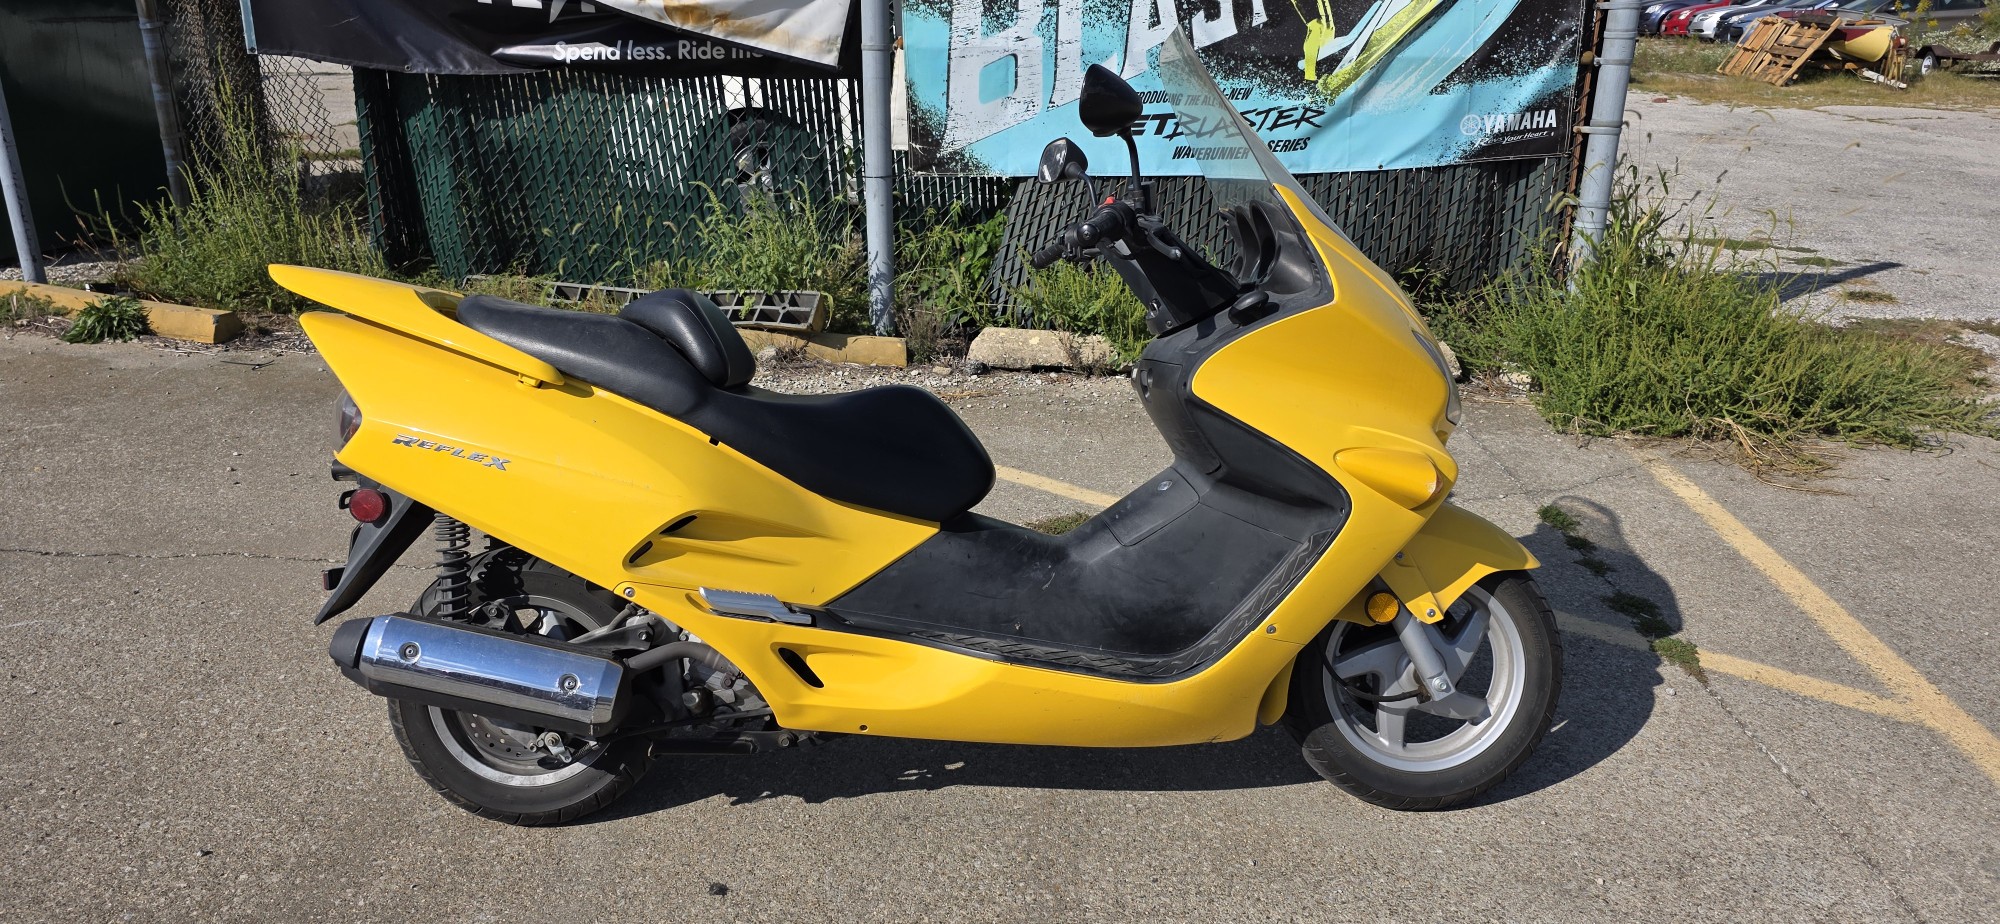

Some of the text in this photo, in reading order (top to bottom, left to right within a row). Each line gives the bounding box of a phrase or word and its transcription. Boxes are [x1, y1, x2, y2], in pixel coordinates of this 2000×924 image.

[552, 41, 621, 63] Spend
[628, 40, 671, 60] less.
[678, 40, 726, 60] Ride
[1130, 106, 1326, 141] ETBLASTER
[1484, 109, 1557, 134] YAMAHA
[1172, 136, 1311, 161] WAVERUNNER SERIES
[392, 433, 511, 471] REFLEX
